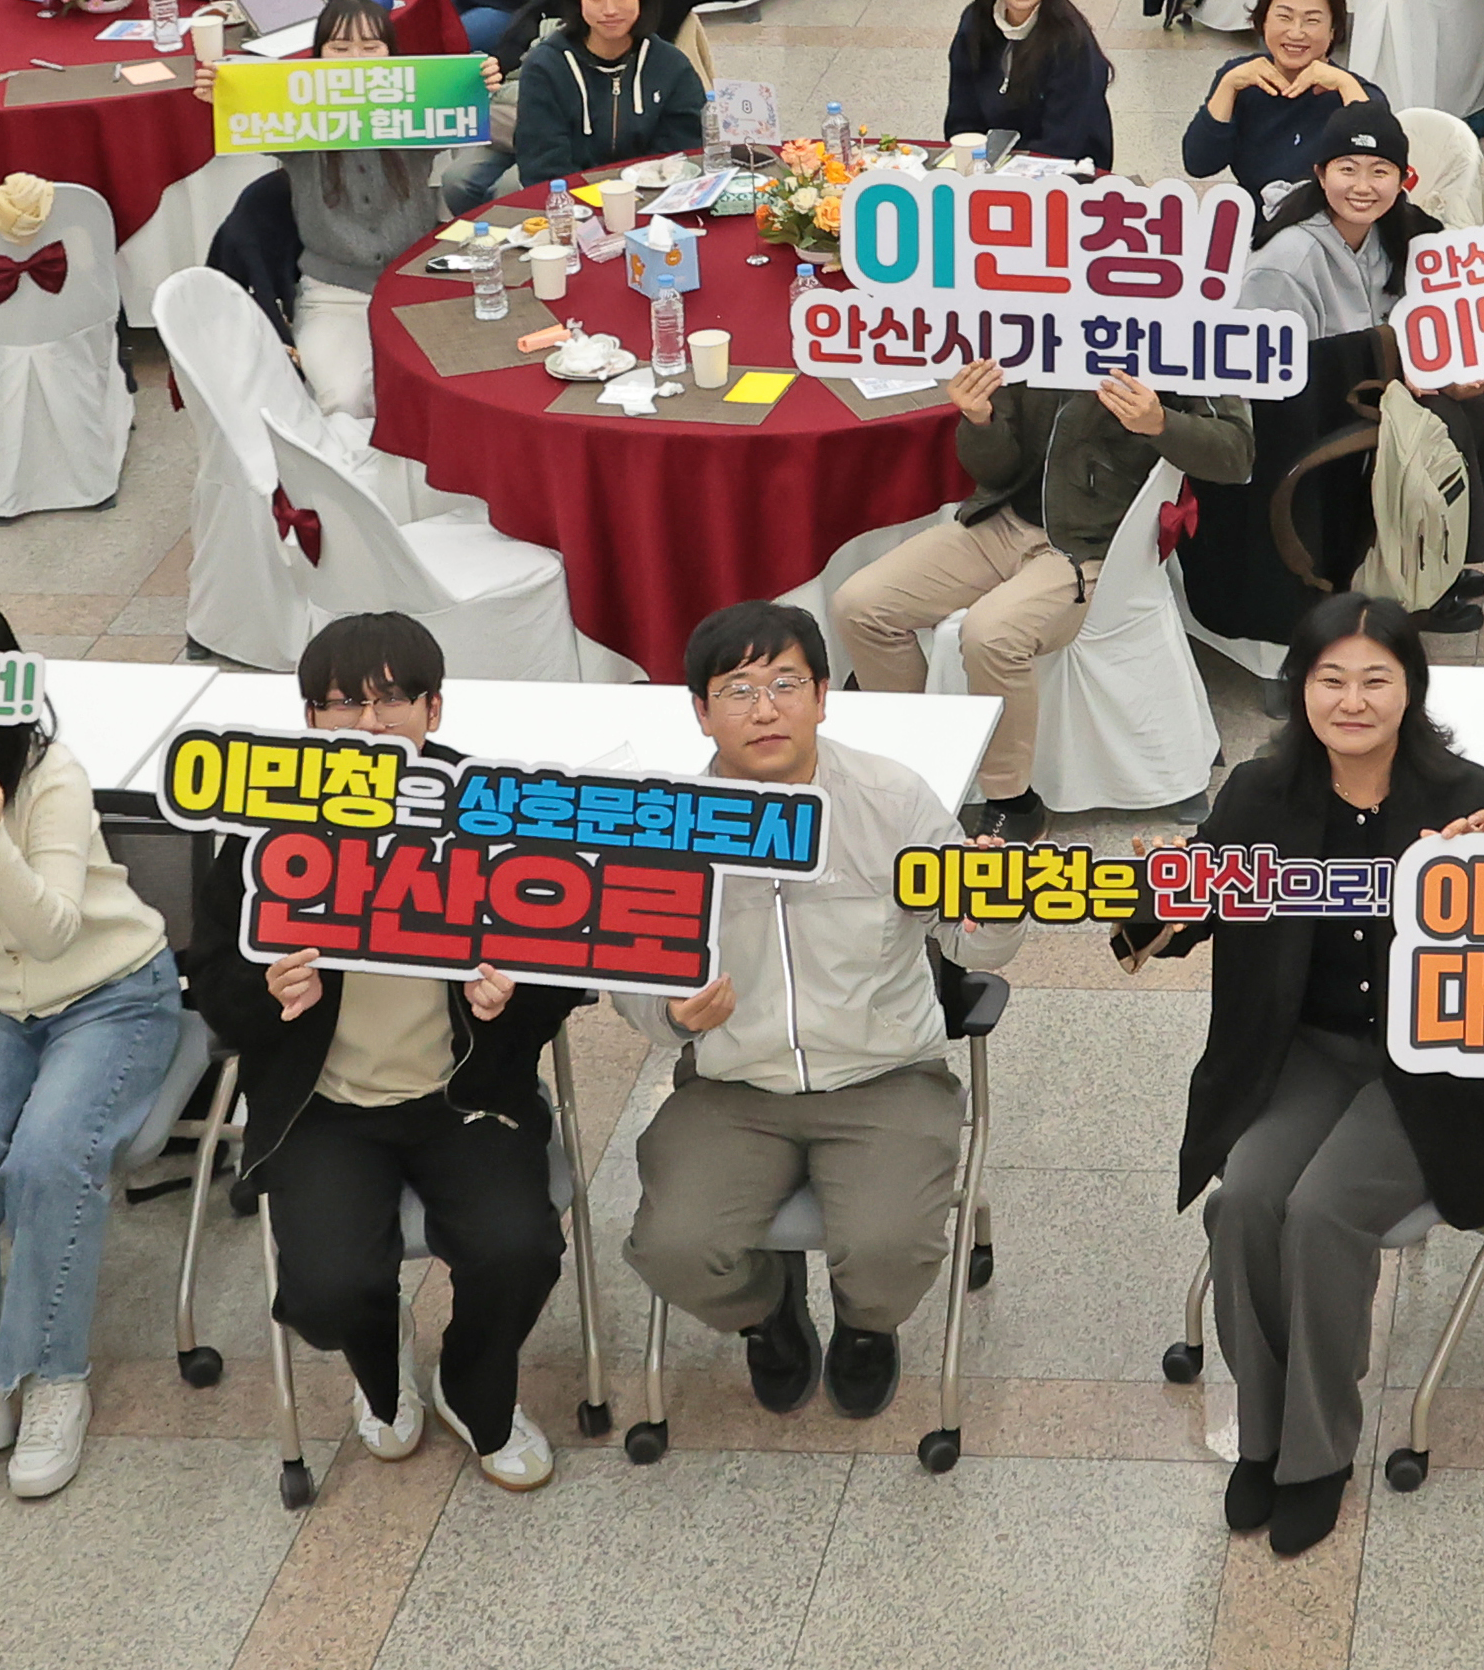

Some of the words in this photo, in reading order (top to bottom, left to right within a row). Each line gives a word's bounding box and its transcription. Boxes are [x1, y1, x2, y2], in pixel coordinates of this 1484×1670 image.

[228, 108, 363, 145] 안산시가
[369, 106, 478, 140] 합니다!
[287, 65, 416, 105] 이민청!
[854, 182, 1241, 302] 이민청!
[804, 303, 1063, 373] 안산시가
[1080, 315, 1294, 384] 합니다!
[172, 739, 448, 829] 이민청은
[457, 775, 814, 863] 상호문화도시
[256, 833, 706, 979] 안산으로
[898, 848, 1140, 921] 이민청은
[1147, 847, 1391, 921] 안산으로!
